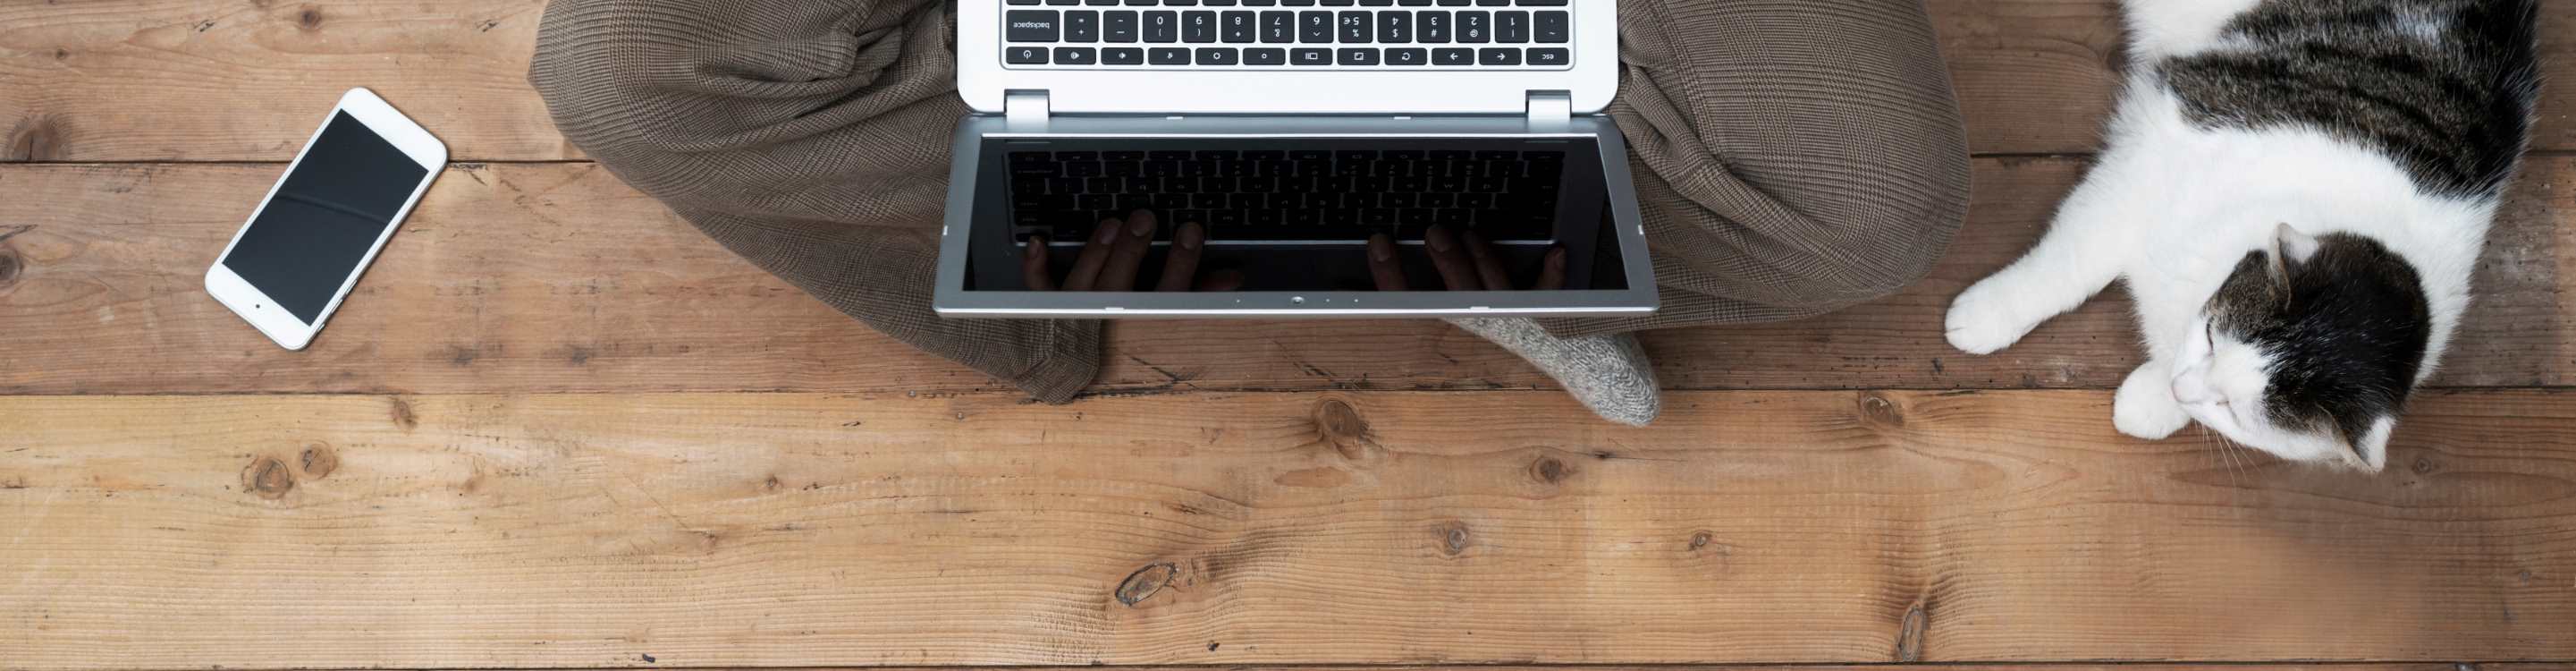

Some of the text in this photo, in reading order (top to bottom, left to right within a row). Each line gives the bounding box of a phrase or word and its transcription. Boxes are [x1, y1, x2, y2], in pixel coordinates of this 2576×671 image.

[1013, 21, 1051, 30] backspace
[1156, 16, 1164, 26] 0
[1195, 16, 1203, 26] 9
[1234, 16, 1242, 26] 8
[1273, 16, 1281, 26] 7
[1313, 16, 1321, 26] 6
[1352, 16, 1360, 26] 5
[1391, 16, 1399, 26] 4
[1431, 16, 1438, 26] 3
[1470, 16, 1478, 26] 2
[1510, 16, 1516, 26] 1
[1274, 28, 1280, 38] &
[1352, 28, 1360, 38] %
[1391, 28, 1398, 38] $
[1431, 29, 1438, 38] #
[1469, 28, 1479, 38] @
